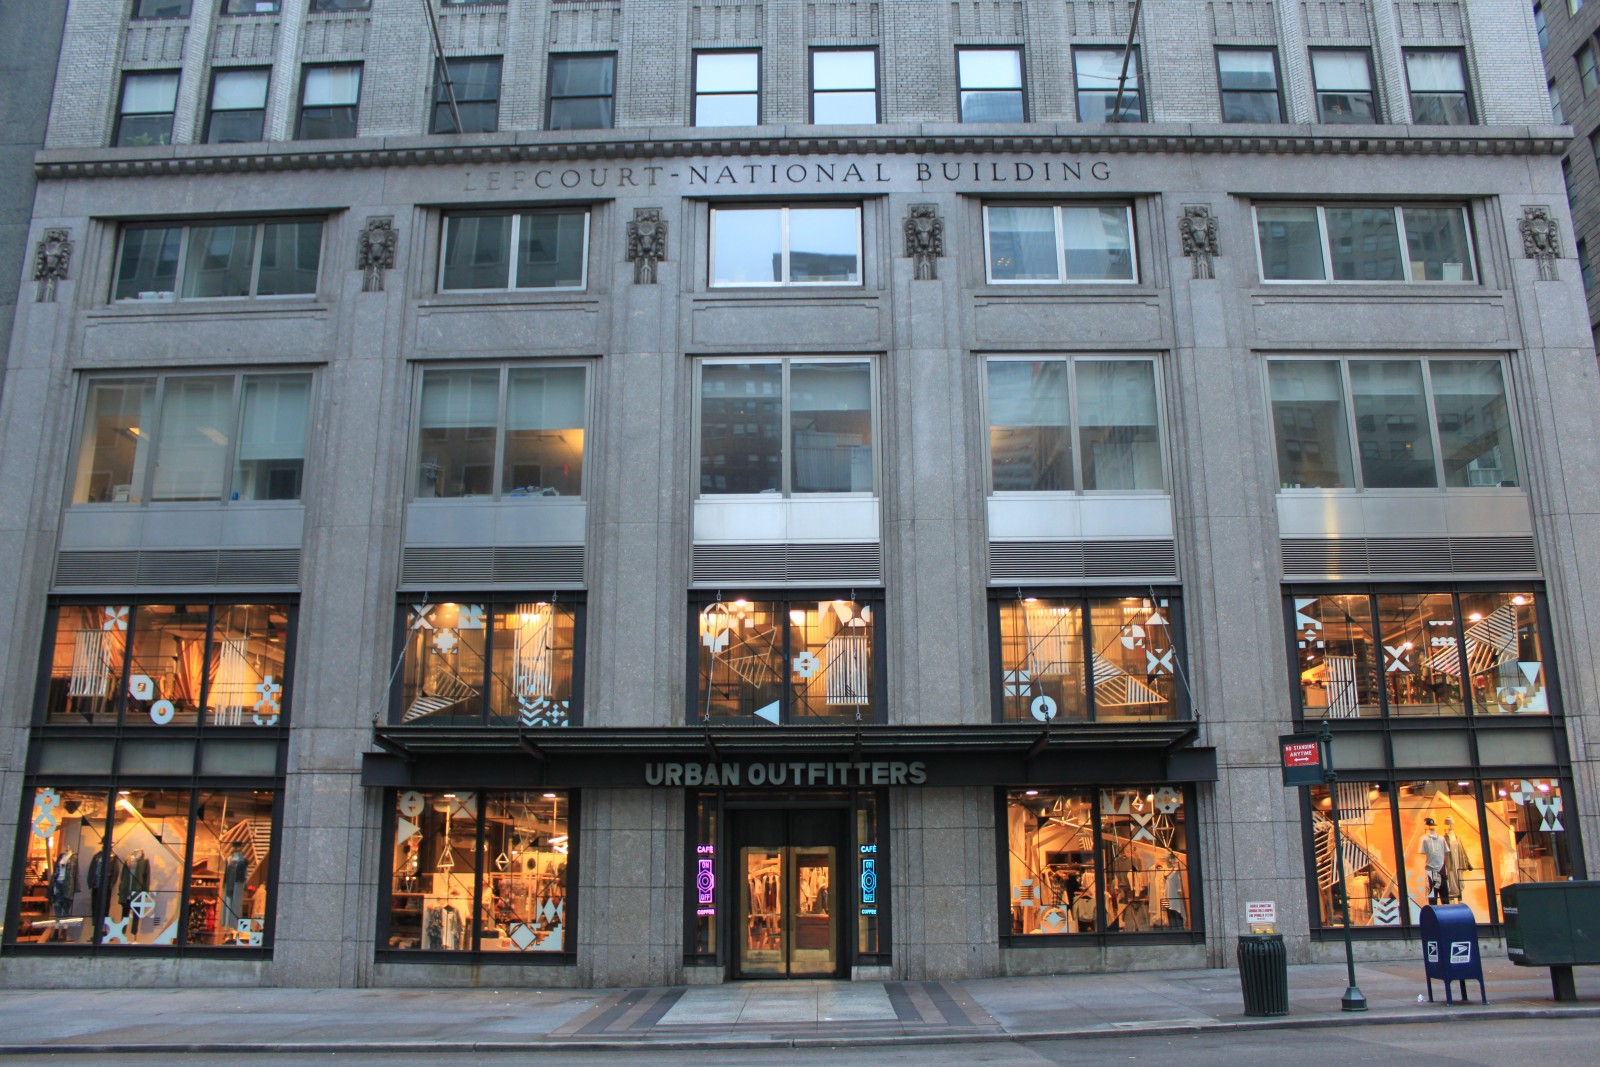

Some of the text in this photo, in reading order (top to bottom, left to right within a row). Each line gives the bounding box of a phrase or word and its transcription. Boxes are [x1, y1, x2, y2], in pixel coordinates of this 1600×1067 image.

[916, 161, 1111, 182] BUILDING
[645, 761, 927, 786] URBAN OUTFITTERS
[701, 861, 710, 869] ON
[865, 861, 873, 869] ON
[700, 893, 711, 901] OFF
[864, 893, 874, 901] OFF
